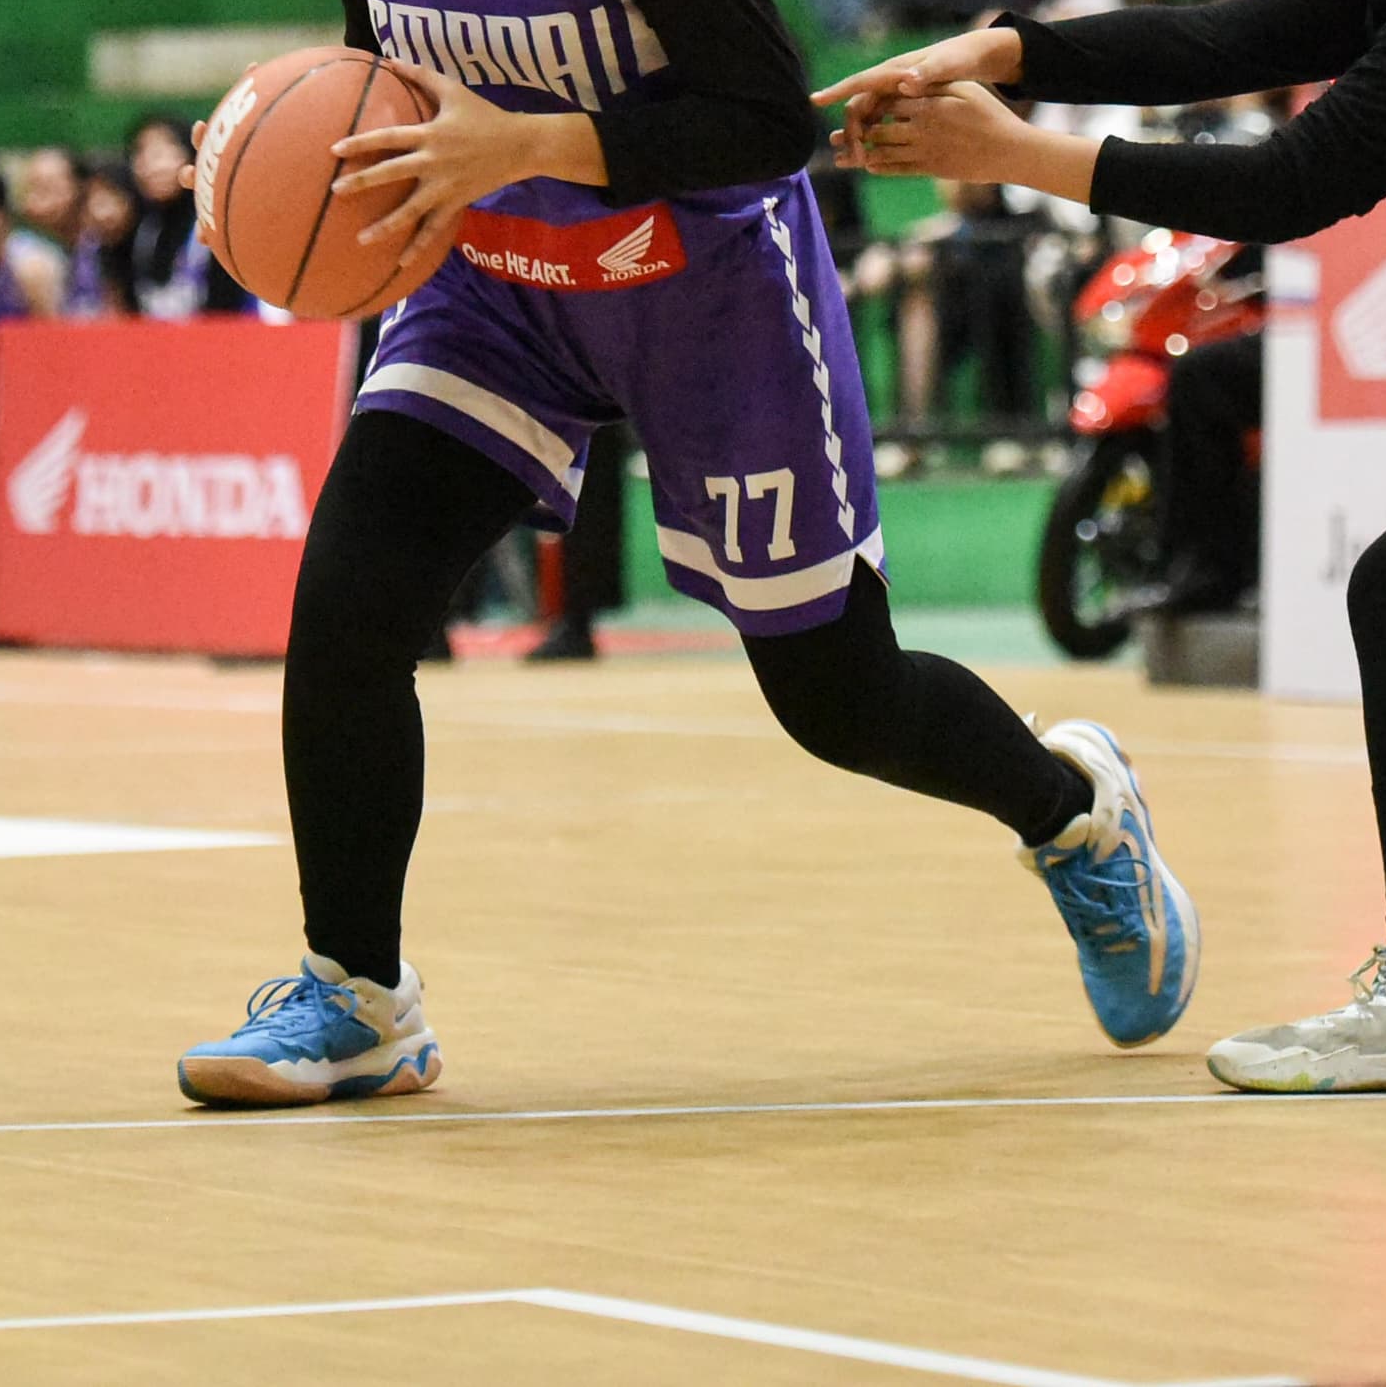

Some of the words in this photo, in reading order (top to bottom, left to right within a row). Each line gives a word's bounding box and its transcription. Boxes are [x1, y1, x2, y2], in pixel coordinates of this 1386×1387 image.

[462, 242, 504, 271] One
[601, 260, 671, 282] HONDA
[72, 452, 311, 538] HONDA
[705, 468, 796, 563] 77
